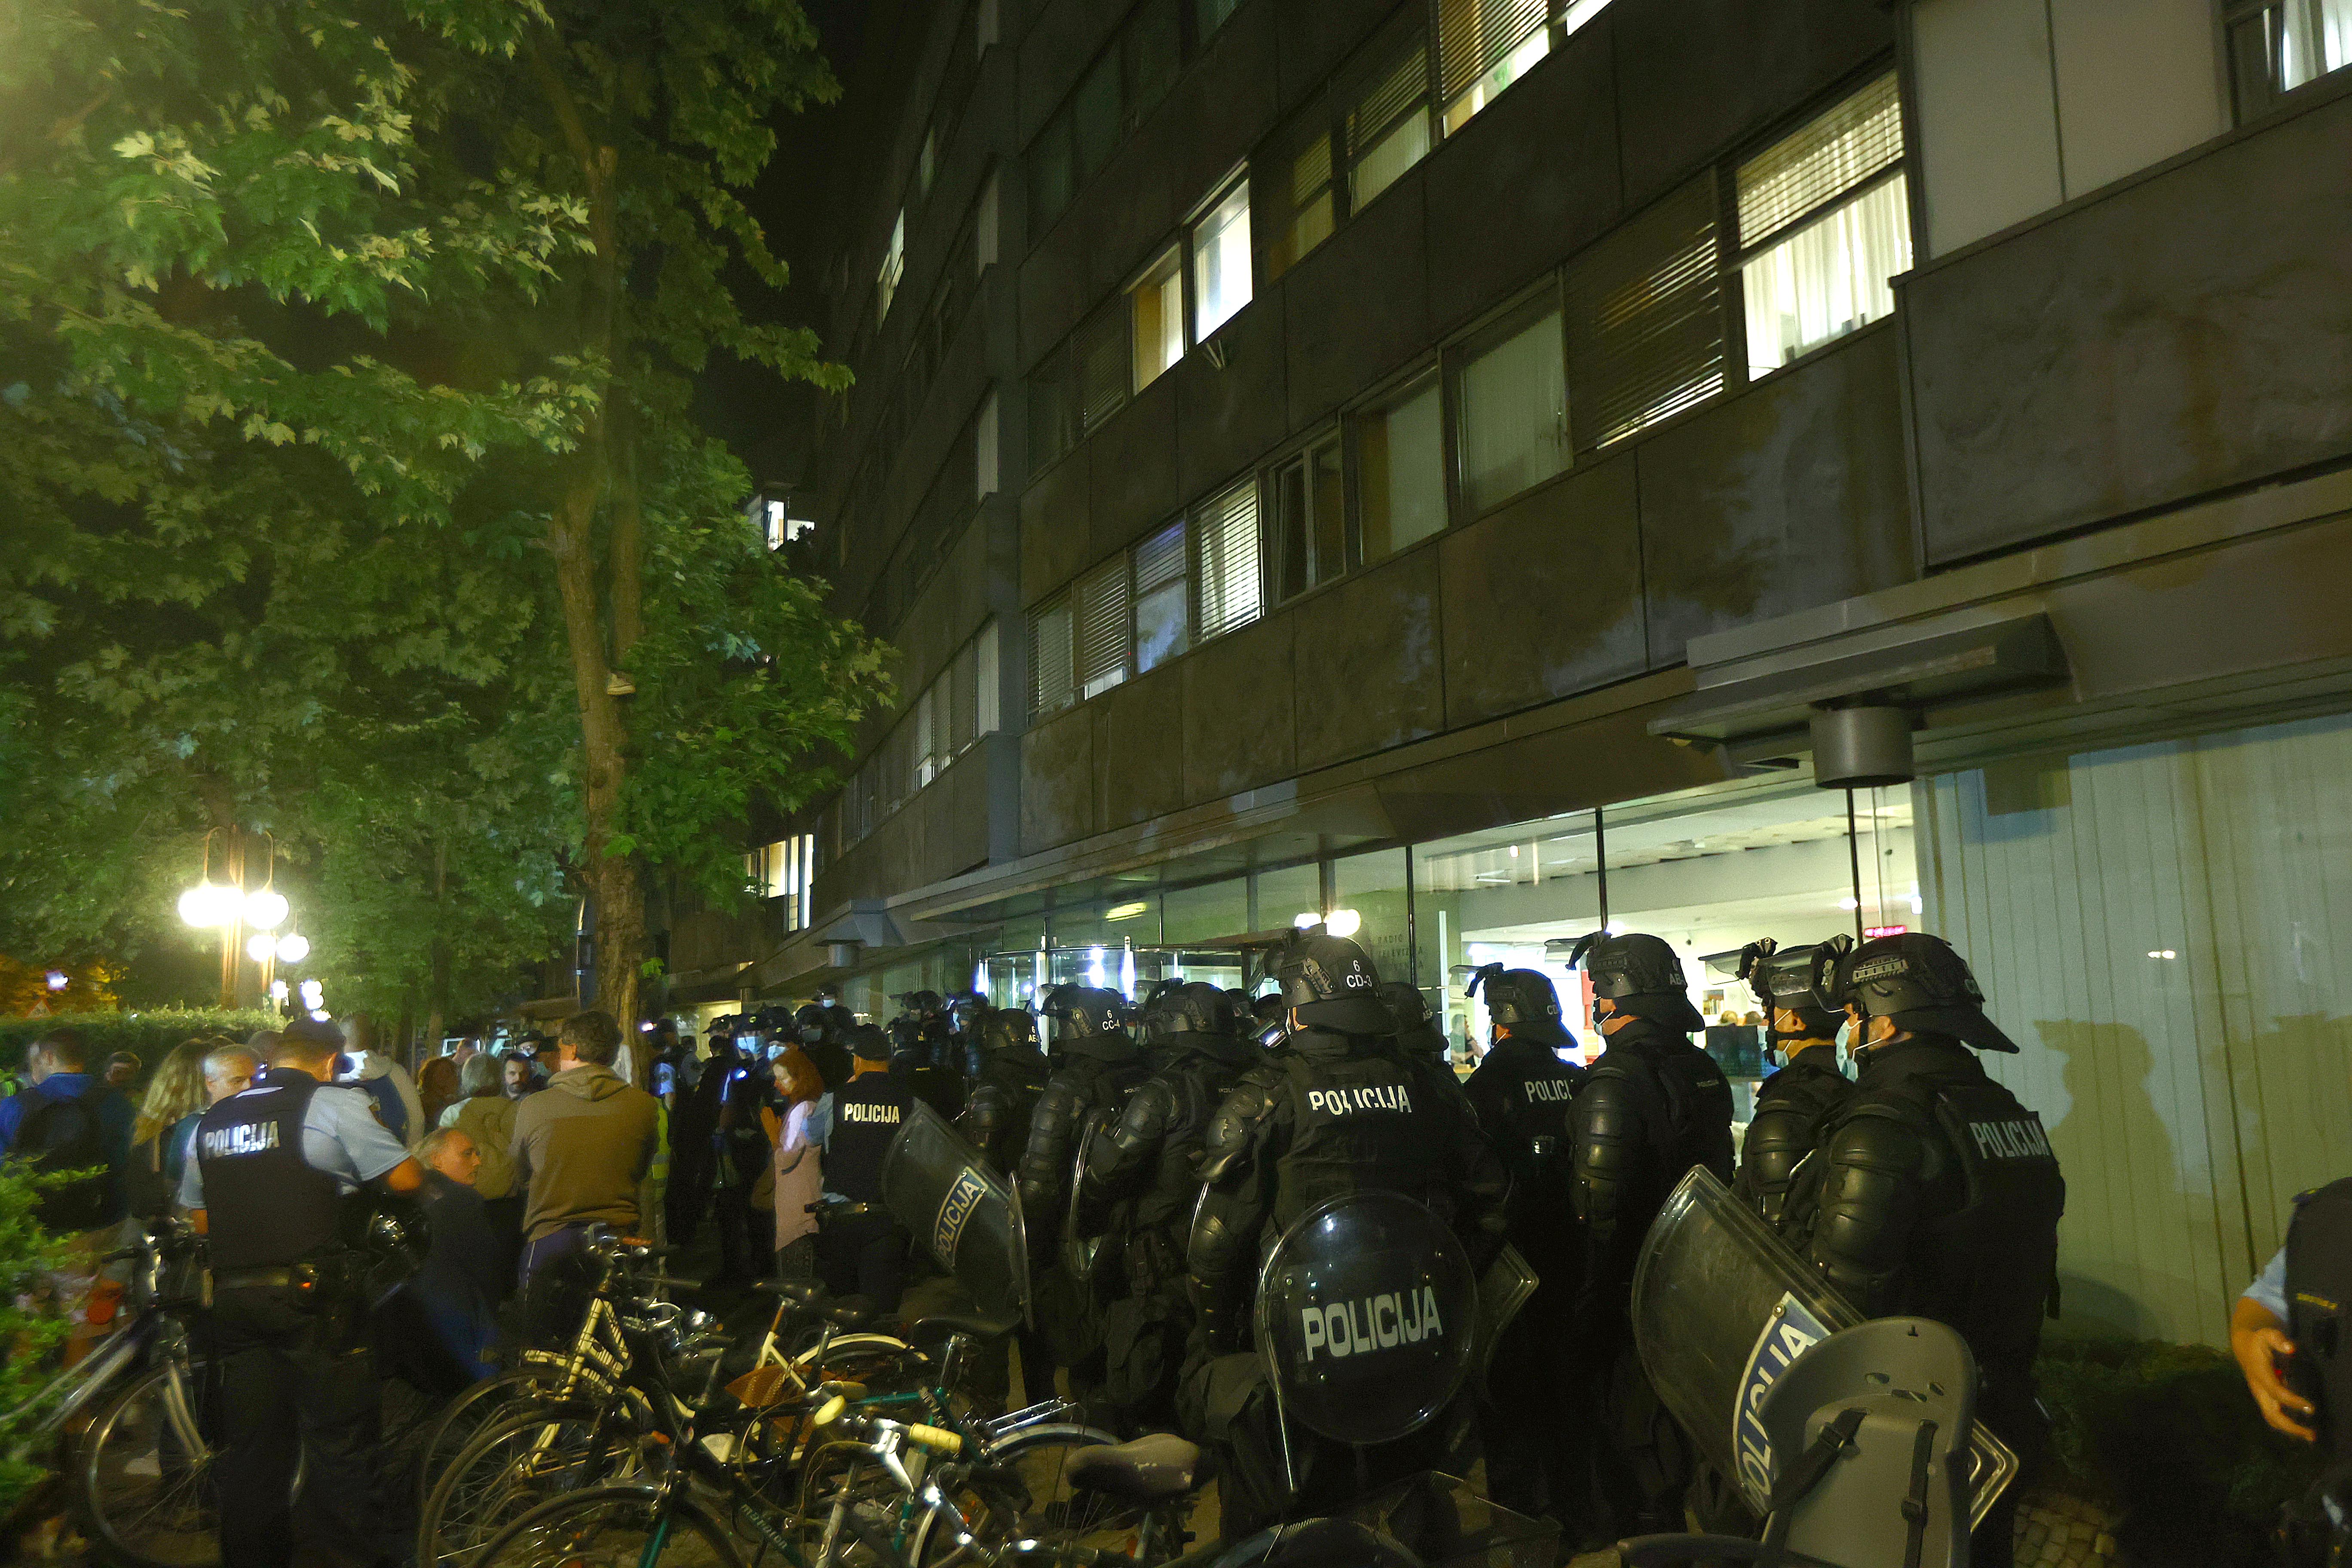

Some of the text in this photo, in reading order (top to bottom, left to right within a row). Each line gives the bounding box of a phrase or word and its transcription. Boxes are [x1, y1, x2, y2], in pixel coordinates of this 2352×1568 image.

[1353, 960, 1361, 972] 6
[1346, 974, 1372, 988] CD-3
[1107, 1009, 1113, 1019] 6
[1031, 1026, 1036, 1034] 6
[1102, 1019, 1120, 1030] CC-4
[1308, 1085, 1412, 1115] POLICIJA
[844, 1103, 900, 1124] POLICIJA
[204, 1121, 280, 1159] POLICIJA
[1969, 1120, 2050, 1159] POLICIJA
[1302, 1286, 1443, 1361] POLICIJA
